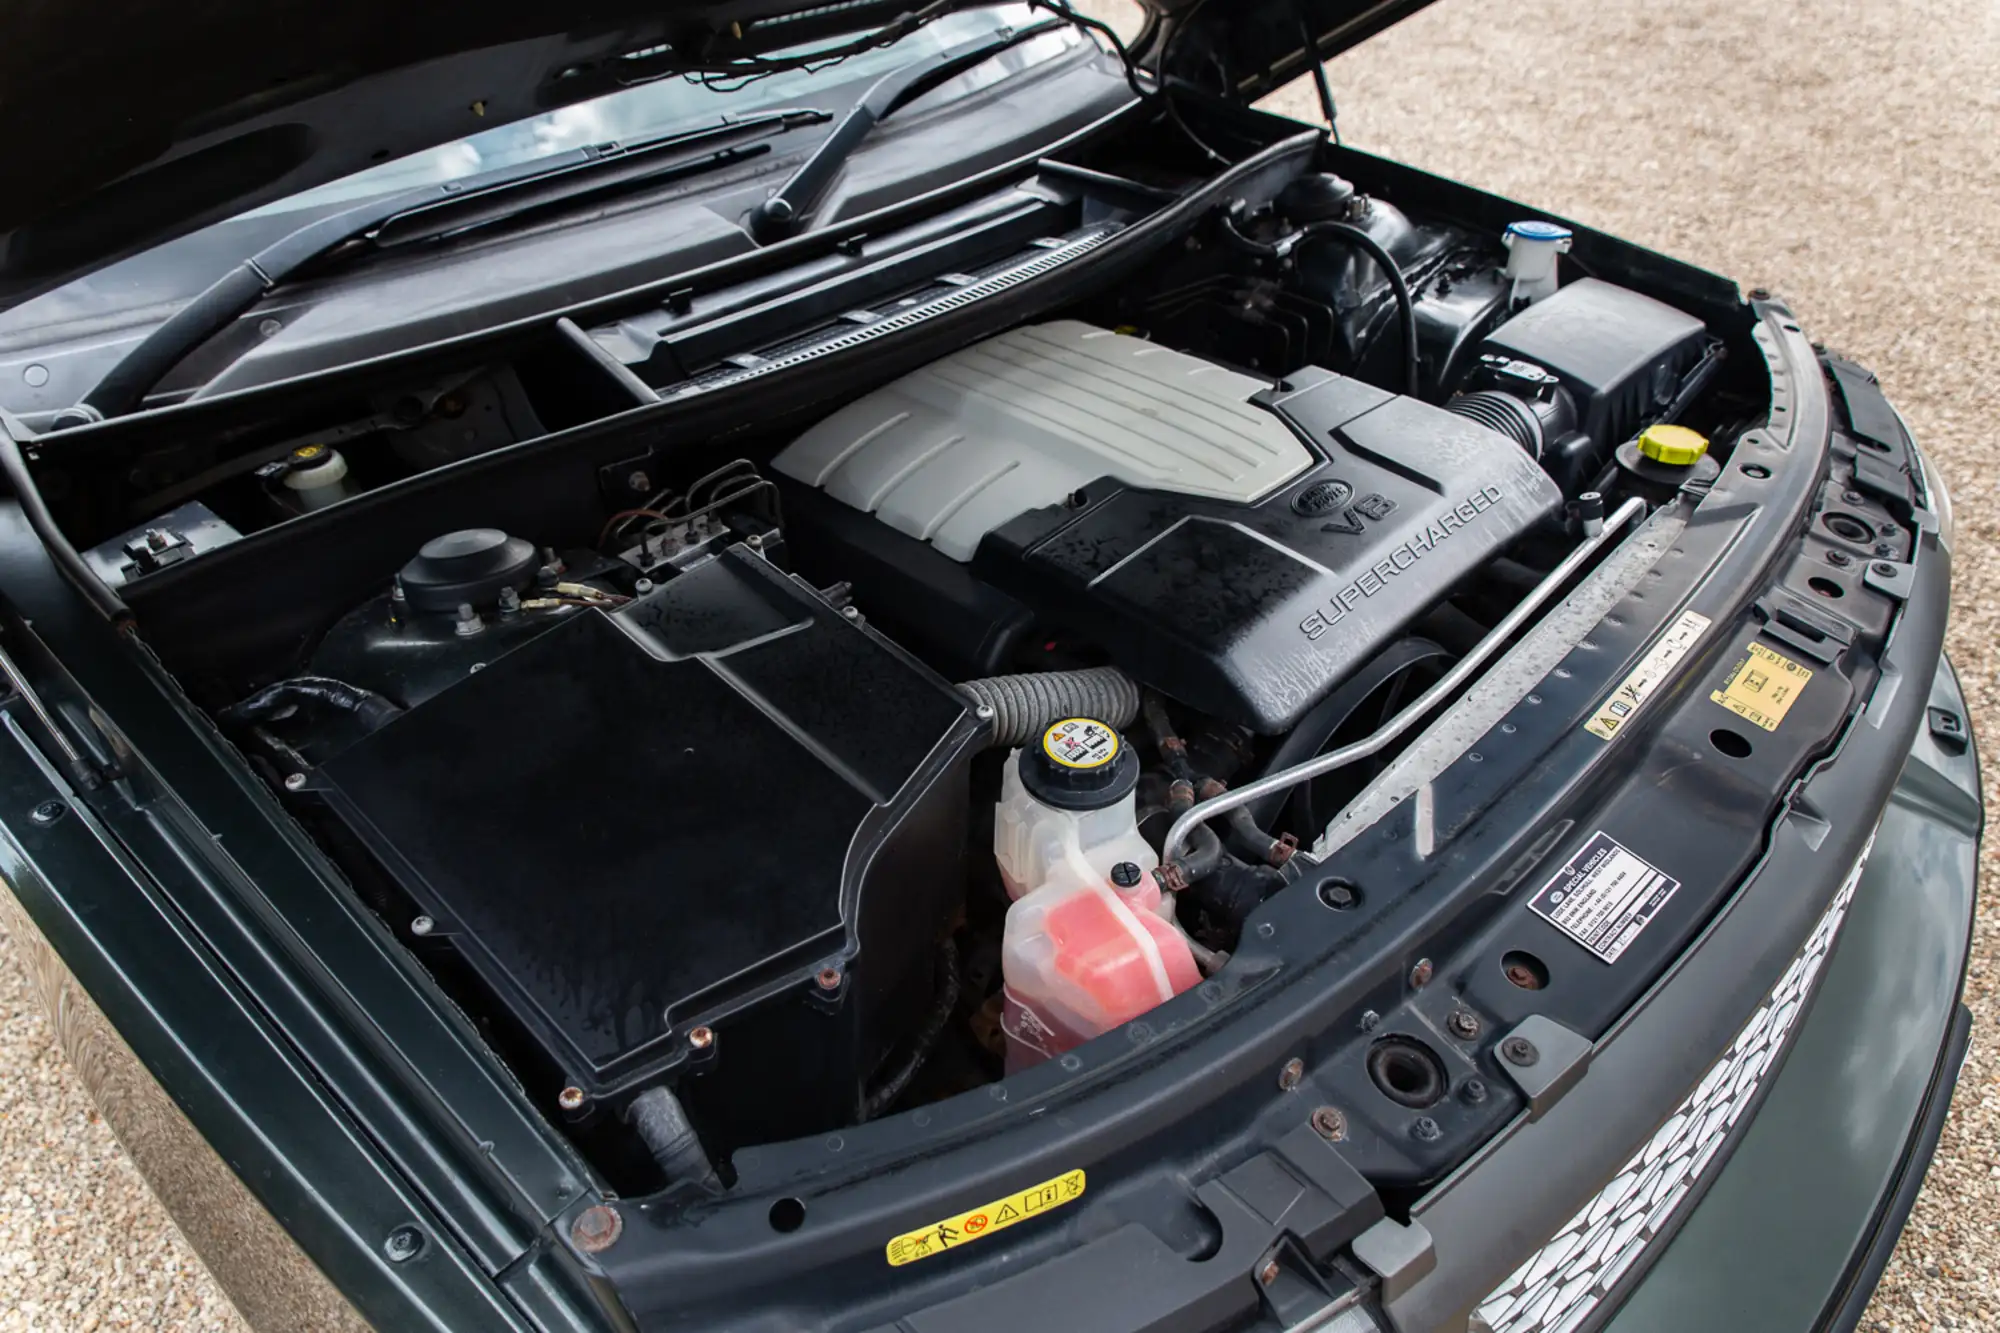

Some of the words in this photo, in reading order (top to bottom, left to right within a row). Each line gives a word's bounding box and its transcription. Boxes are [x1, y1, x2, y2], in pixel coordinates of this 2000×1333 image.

[1321, 492, 1399, 535] V8
[1300, 484, 1503, 641] SUPERCHARGED
[1563, 870, 1586, 892] SPECIAL
[1582, 848, 1608, 873] VEHICLES
[1590, 866, 1603, 878] WEST
[1600, 848, 1621, 868] MIDLANDS
[1576, 888, 1597, 908] ENGLAND
[1569, 907, 1593, 930] TELEPHONE
[1587, 930, 1601, 943] PAINT
[1597, 919, 1611, 932] CODE
[1597, 927, 1618, 950] CONTRACT
[1615, 911, 1633, 929] NUMBER
